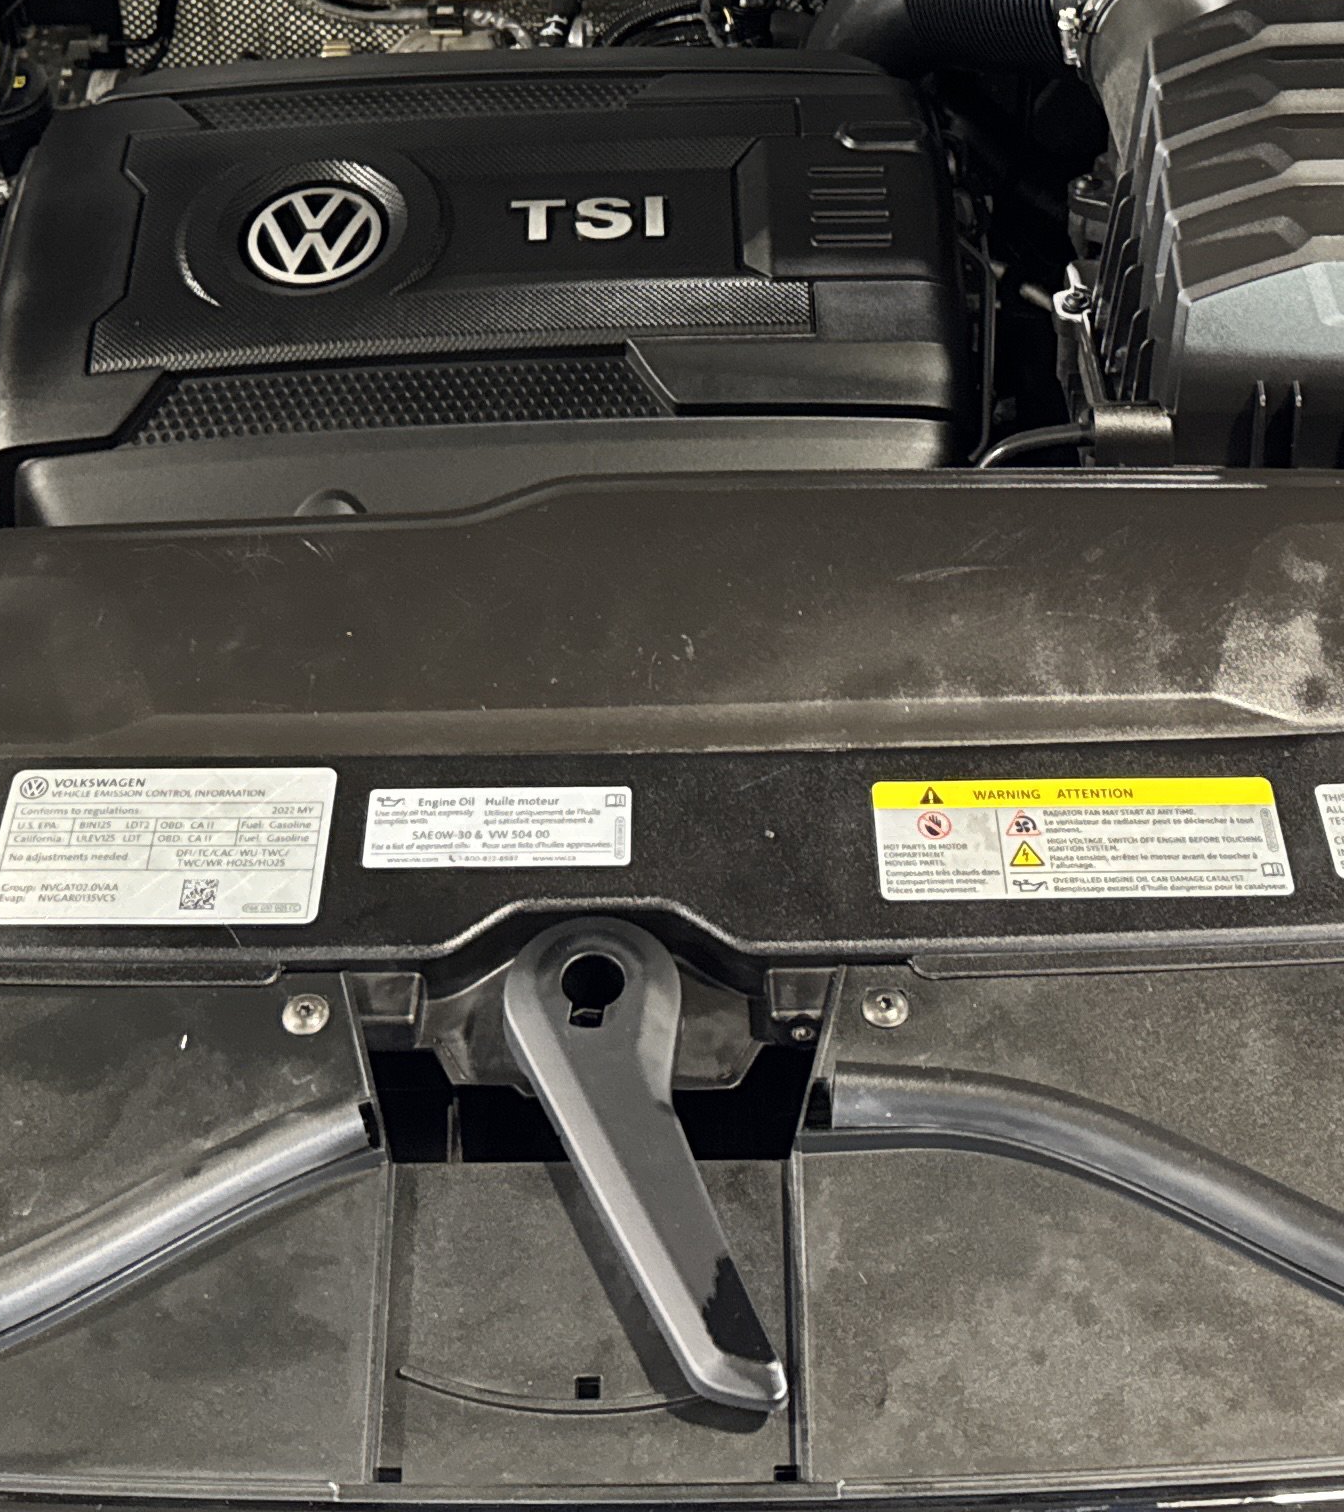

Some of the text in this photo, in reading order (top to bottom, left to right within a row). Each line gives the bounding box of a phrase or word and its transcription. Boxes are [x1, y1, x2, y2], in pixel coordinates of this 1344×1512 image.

[510, 194, 667, 241] TSI
[54, 778, 146, 788] VOLKSWAGEN
[194, 789, 266, 797] INFORMATION
[973, 789, 1134, 801] WARNING ATTENTION
[418, 797, 475, 808] Engine Oil
[485, 797, 559, 806] Huile moteur
[21, 807, 68, 815] Conforms
[272, 806, 314, 814] 2022 MY
[79, 821, 150, 829] BIN125 LDT2
[190, 821, 204, 829] CA
[267, 834, 309, 842] Gasoline
[474, 830, 483, 839] &
[488, 830, 508, 839] VW
[512, 830, 532, 839] 504
[535, 830, 550, 839] 00
[8, 852, 128, 863] No adjustments needed
